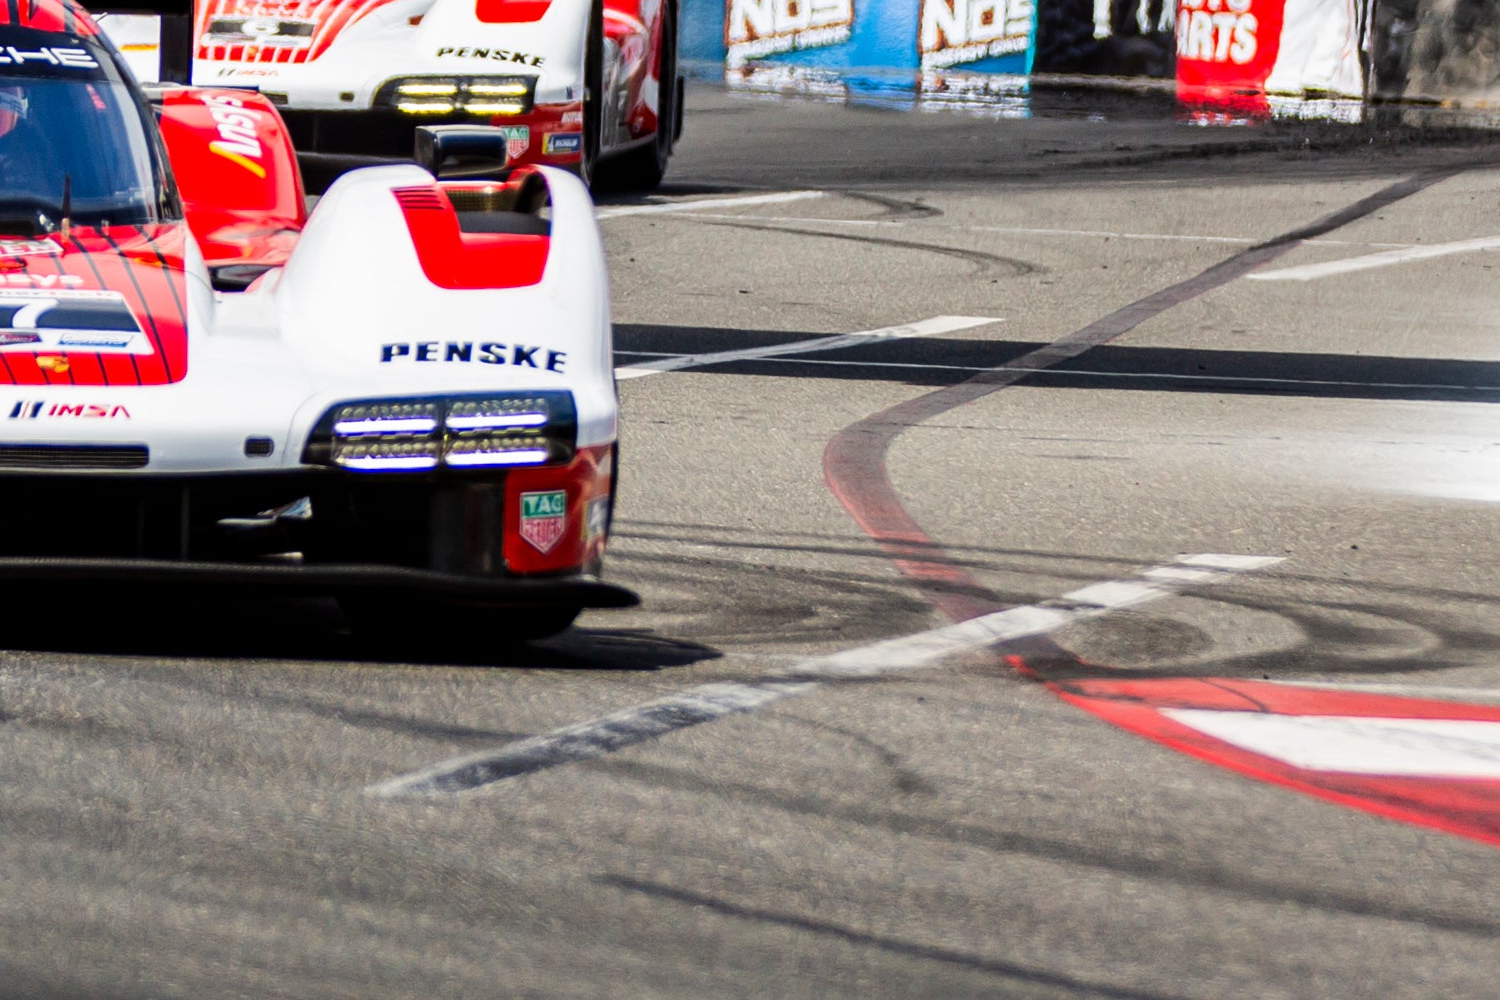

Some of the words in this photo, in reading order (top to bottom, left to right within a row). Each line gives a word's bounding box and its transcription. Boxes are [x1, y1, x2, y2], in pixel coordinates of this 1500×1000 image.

[436, 46, 546, 68] PENSKE
[379, 341, 568, 375] PENSKE
[526, 493, 563, 515] TAG
